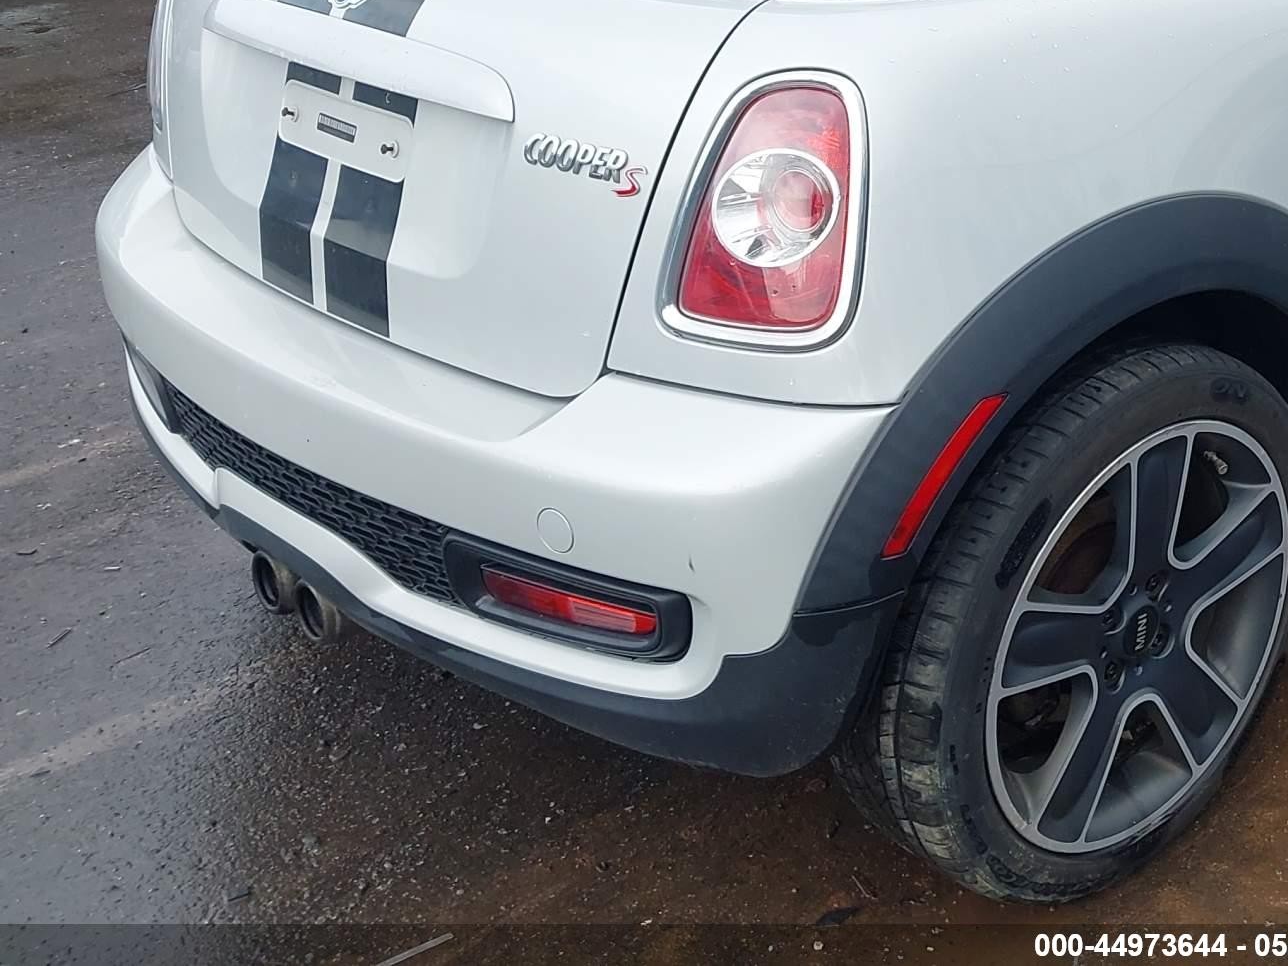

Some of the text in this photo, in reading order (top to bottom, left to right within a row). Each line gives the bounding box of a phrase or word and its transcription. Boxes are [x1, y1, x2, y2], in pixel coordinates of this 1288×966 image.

[523, 133, 649, 197] COOPER S
[1134, 613, 1148, 651] MINI
